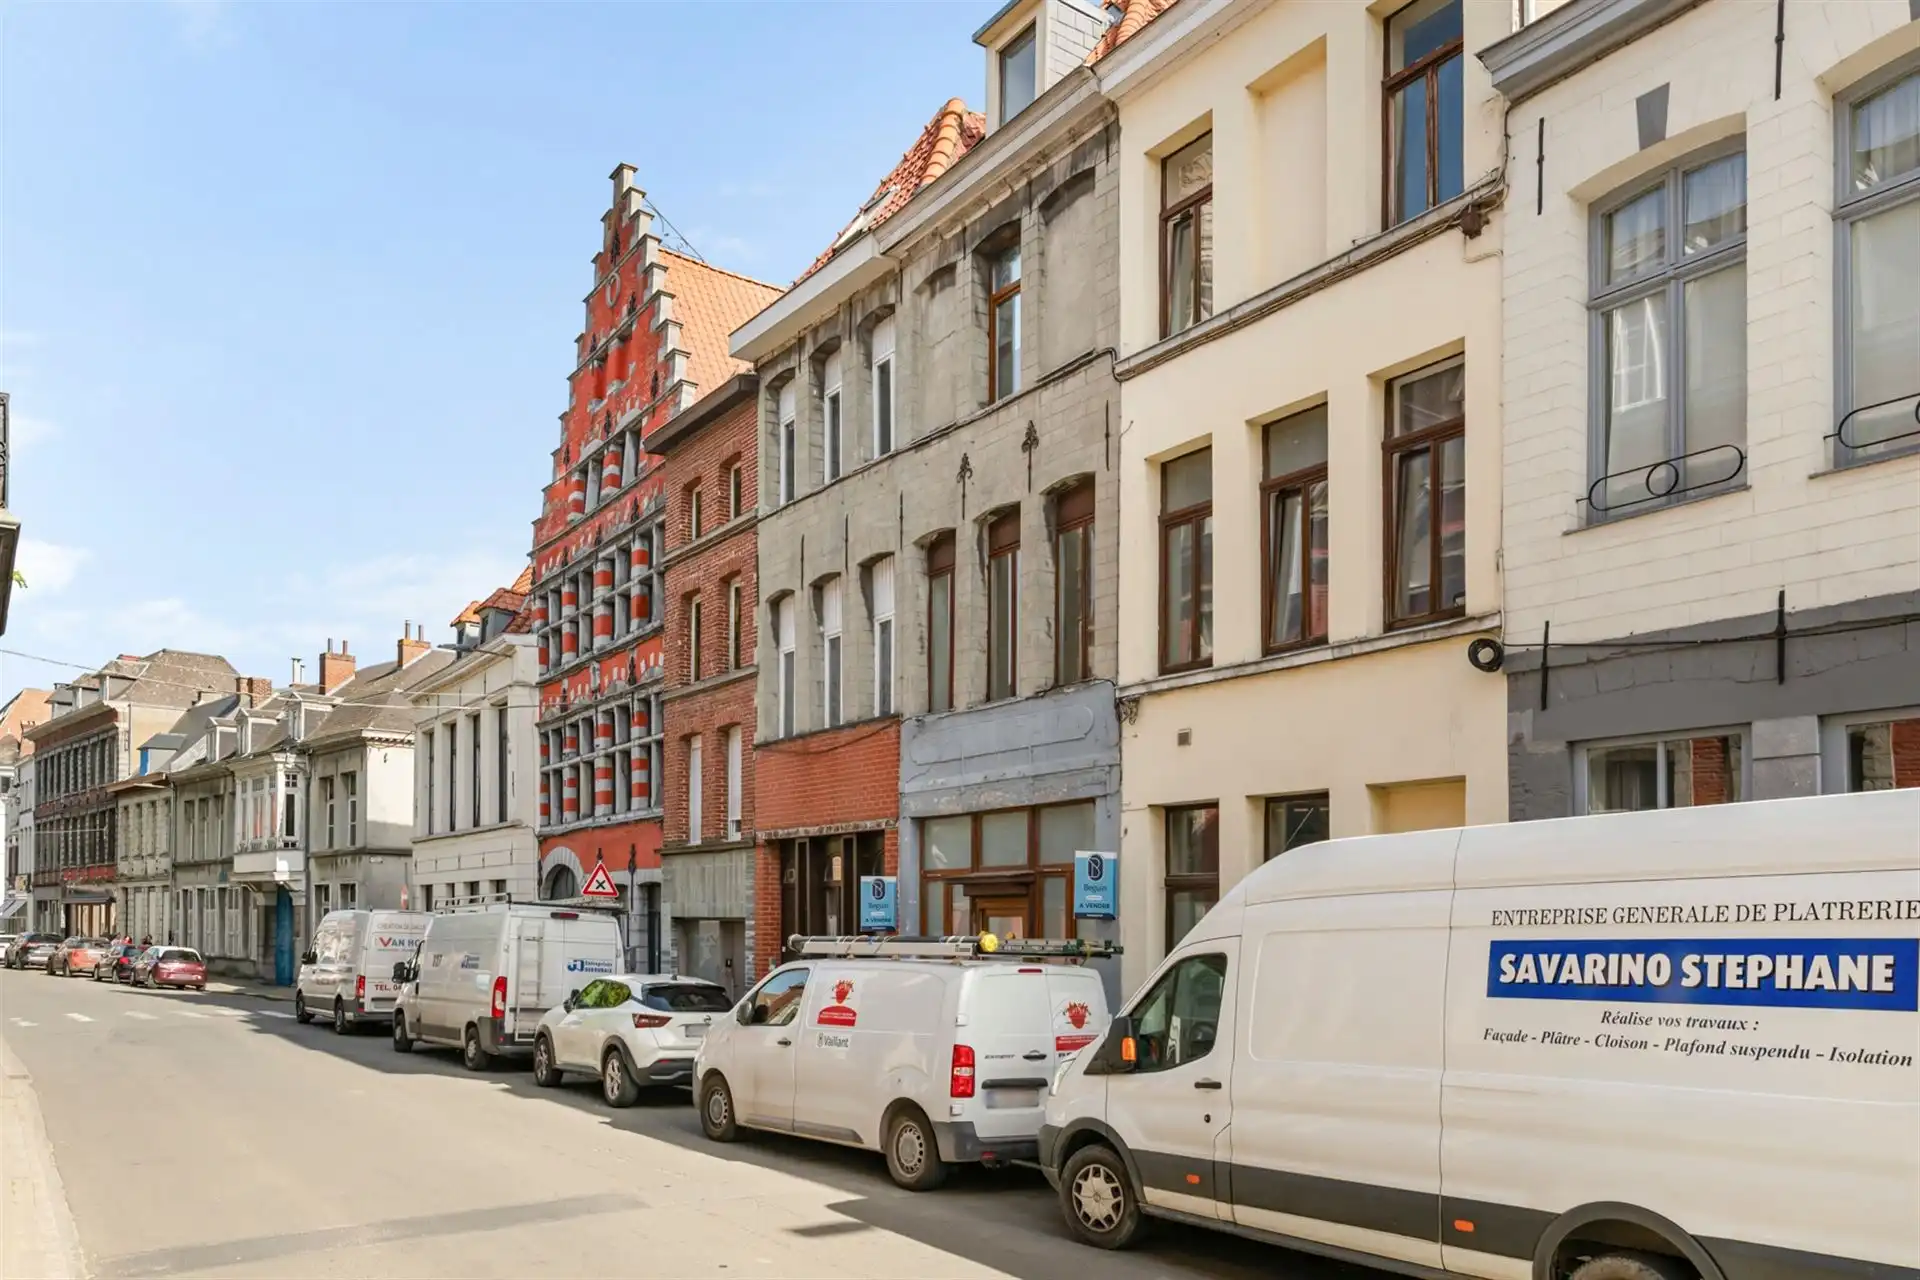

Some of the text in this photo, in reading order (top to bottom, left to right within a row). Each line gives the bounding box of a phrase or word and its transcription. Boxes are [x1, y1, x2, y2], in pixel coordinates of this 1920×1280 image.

[1491, 899, 1920, 926] ENTREPRISE GENERALE DE PLATRERIE
[379, 936, 405, 948] VAN
[1499, 952, 1896, 992] SAVARINO STEPHANE
[1600, 1010, 1653, 1026] Réalise
[1658, 1016, 1681, 1027] vos
[1686, 1016, 1748, 1031] travaux
[824, 1035, 849, 1048] Vaillant
[1483, 1028, 1528, 1044] Façade
[1540, 1031, 1581, 1046] Plâtre
[1594, 1034, 1648, 1050] Cloison
[1663, 1038, 1726, 1057] Plafond
[1730, 1044, 1810, 1061] suspendu
[1829, 1047, 1913, 1067] Isolation
